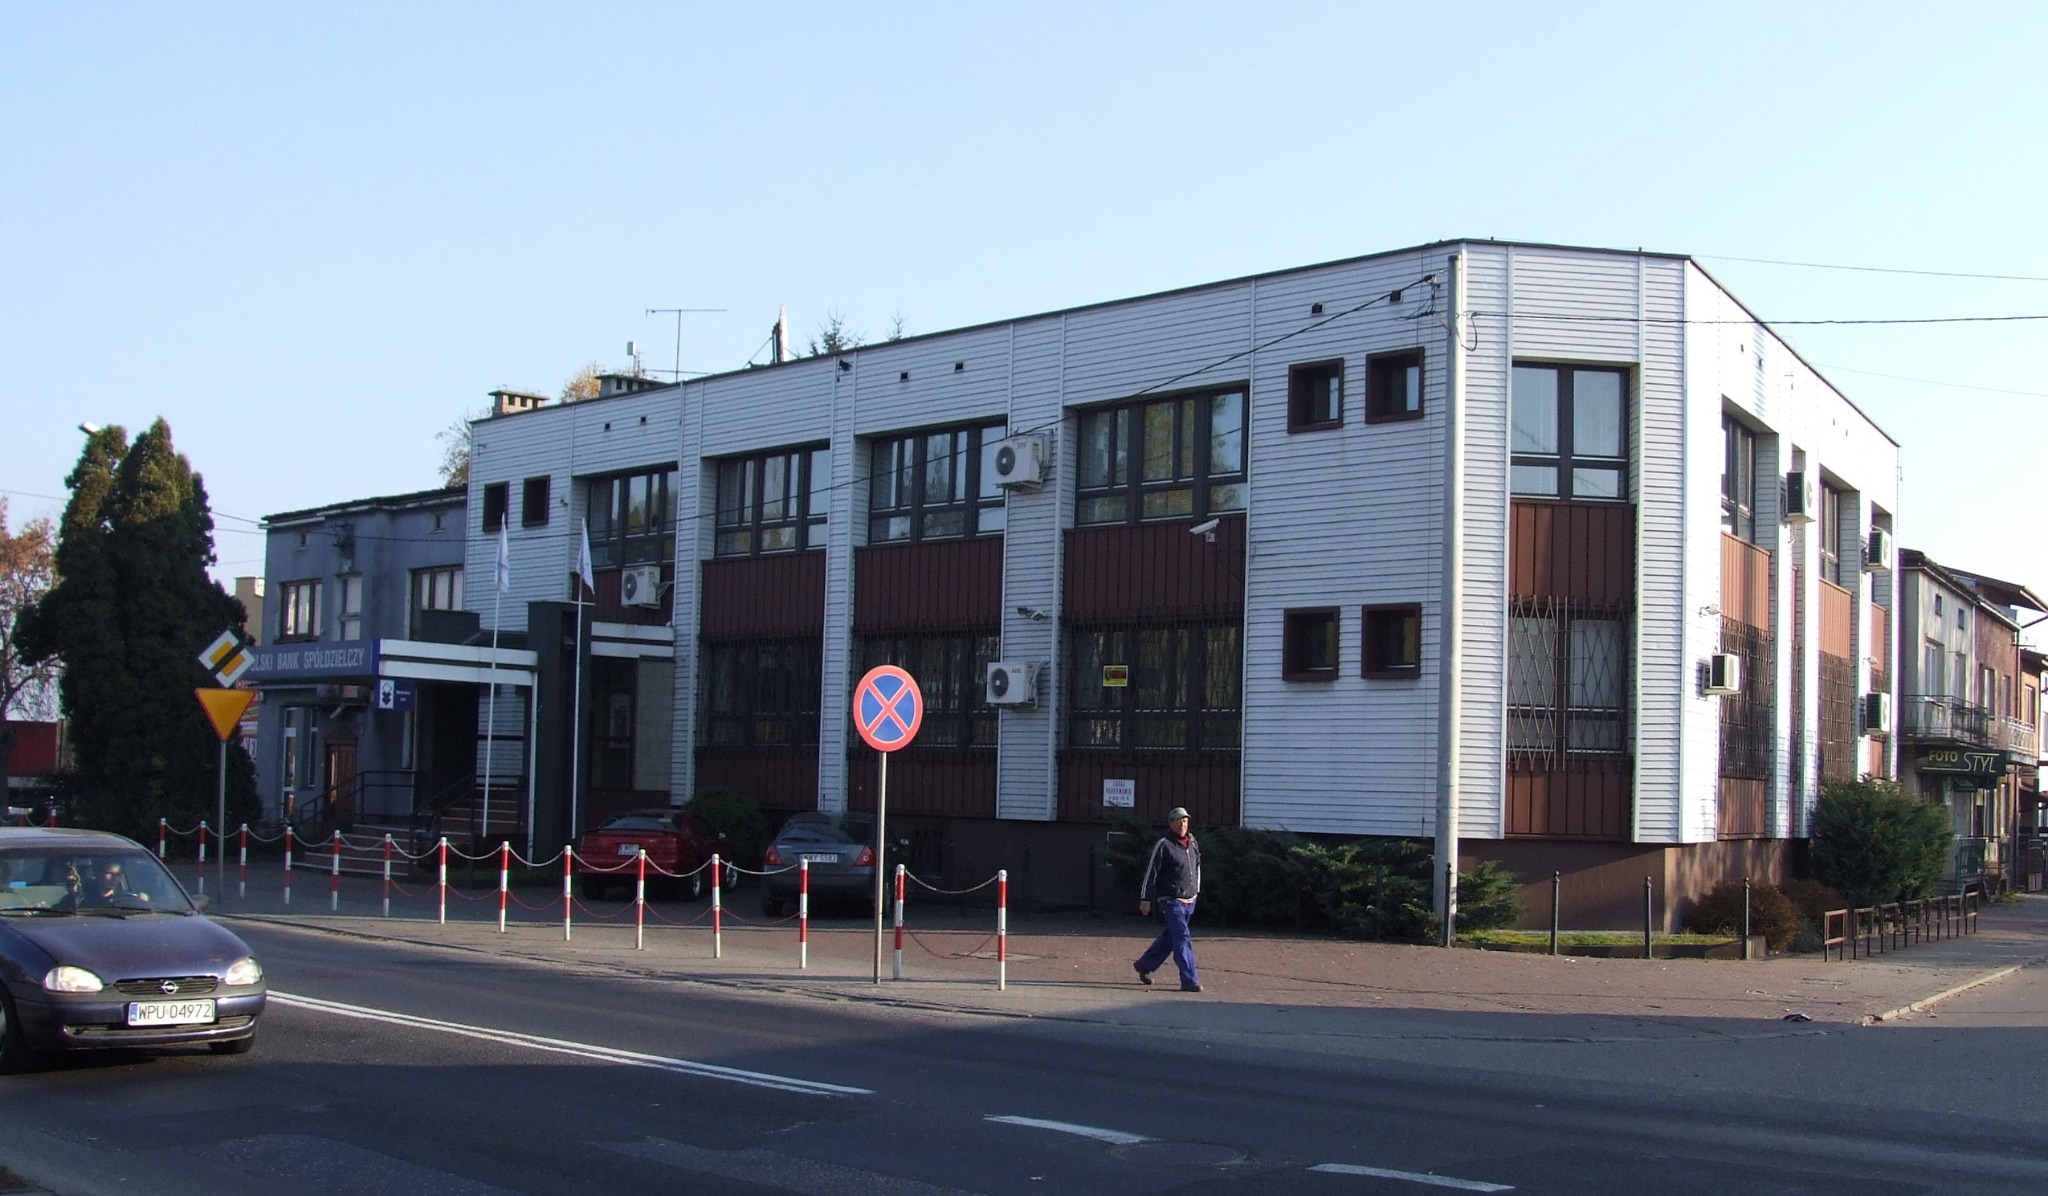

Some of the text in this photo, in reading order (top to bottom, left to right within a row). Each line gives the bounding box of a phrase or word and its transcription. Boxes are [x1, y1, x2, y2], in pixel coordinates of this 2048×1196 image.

[277, 652, 299, 670] BANK
[303, 646, 364, 669] SPÓŁDZIELCZY
[1928, 751, 1998, 773] FOTO STYL
[139, 1005, 165, 1020] WPU
[170, 1004, 211, 1018] 04972
